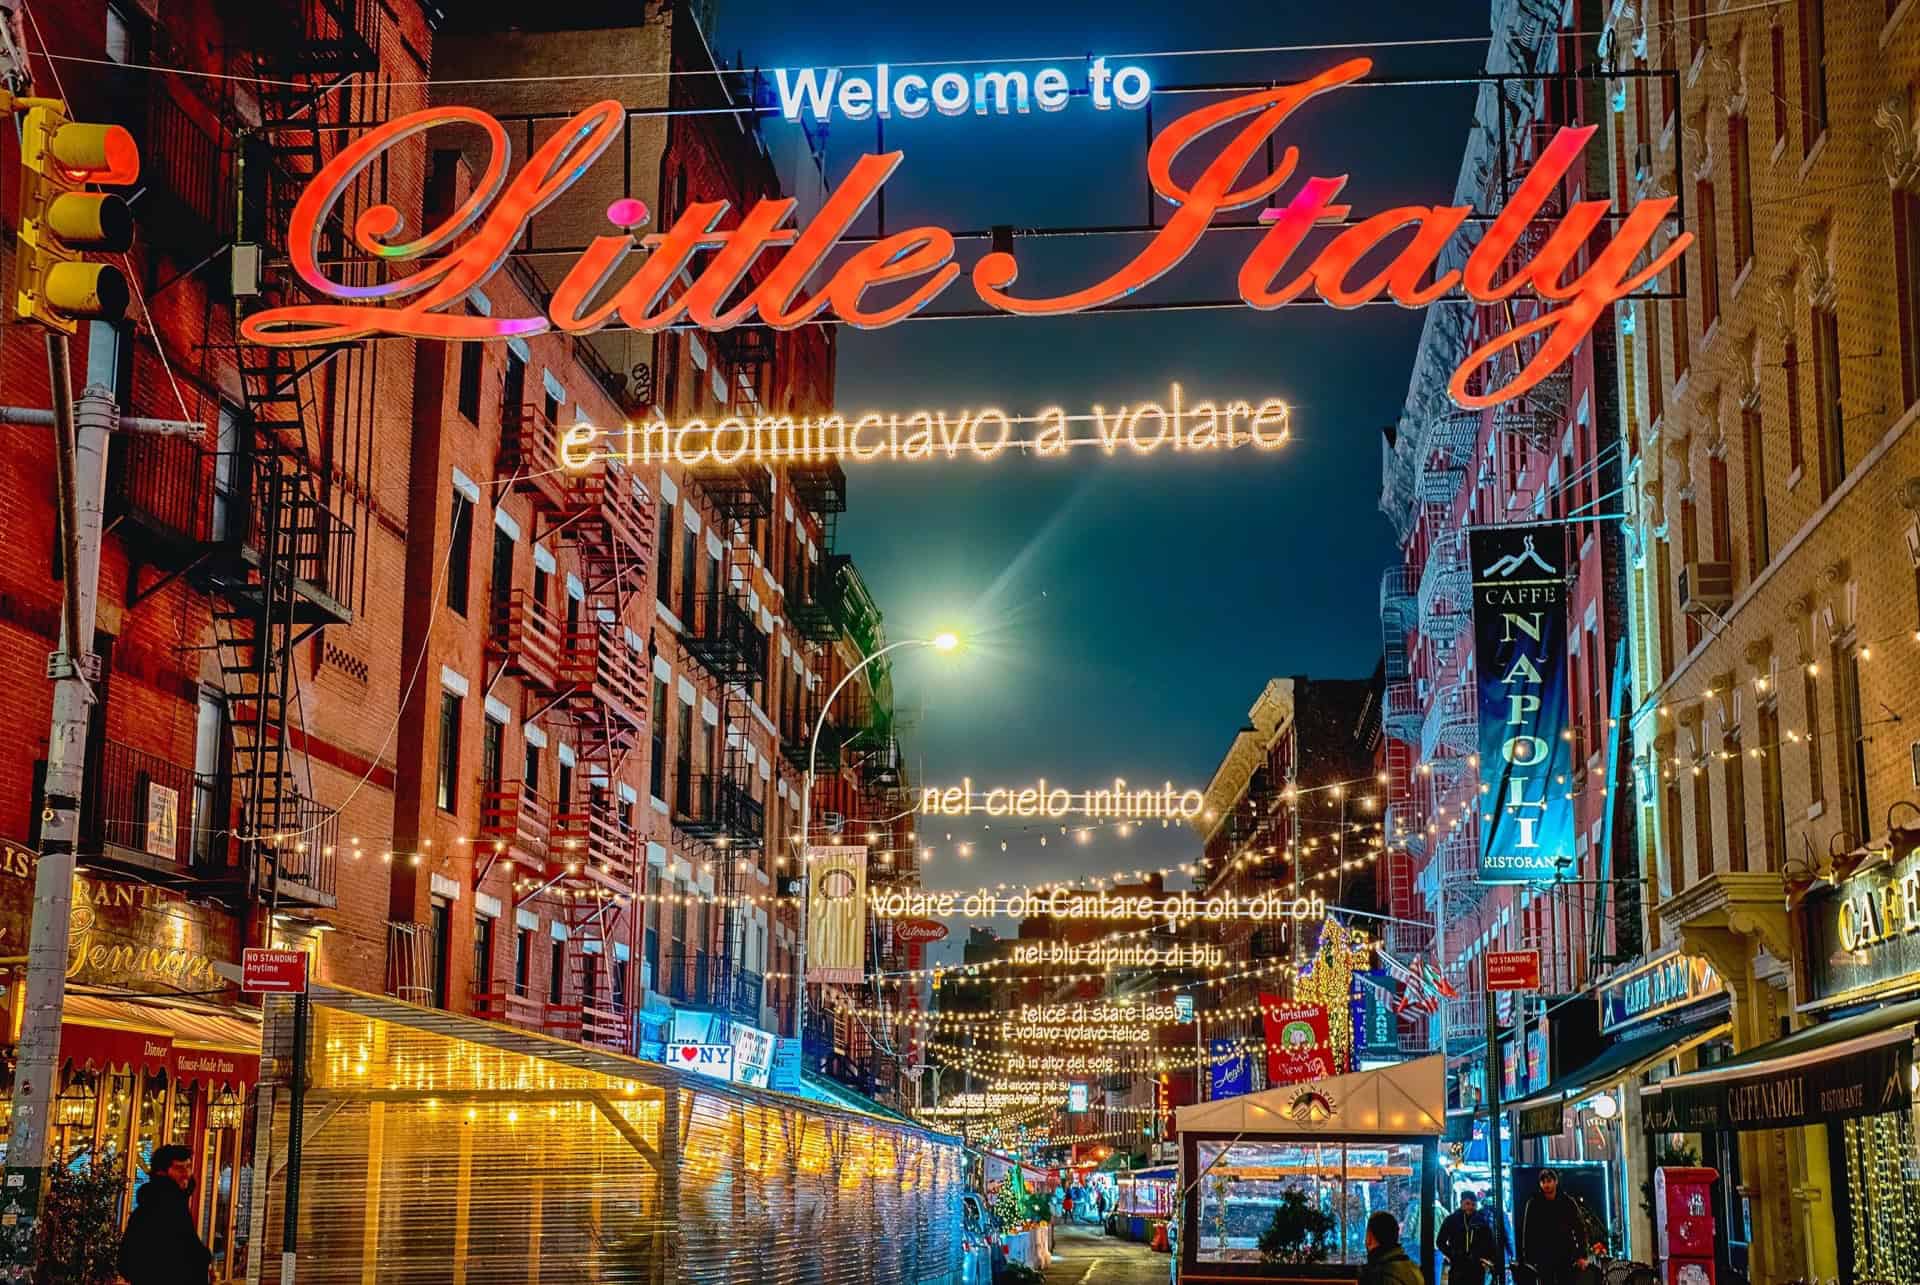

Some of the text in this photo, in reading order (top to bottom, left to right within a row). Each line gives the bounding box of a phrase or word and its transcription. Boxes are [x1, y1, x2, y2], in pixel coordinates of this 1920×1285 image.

[774, 56, 1152, 124] Welcome to
[241, 57, 1694, 409] Little Italy
[560, 383, 1293, 470] e incominciavo a volare
[1485, 586, 1556, 605] CAFFE
[1500, 612, 1549, 848] NAPOLI
[922, 777, 1204, 819] nel cielo infinito
[871, 886, 1325, 919] Volare oh oh Cantare oh oh oh oh
[896, 922, 948, 940] Ristorante
[247, 955, 298, 963] NO STANDING
[1014, 941, 1221, 971] nel blu dipinto di blu
[1489, 956, 1532, 965] NO STANDING
[247, 964, 279, 973] Anytime
[1489, 966, 1516, 974] Anytime
[1022, 1003, 1066, 1023] felice
[1072, 1004, 1088, 1022] di
[1093, 1002, 1136, 1022] stare
[1271, 1007, 1320, 1023] Christmas
[1016, 1022, 1059, 1040] volavo
[1065, 1022, 1107, 1041] volavo
[1112, 1022, 1150, 1042] felice
[144, 1041, 168, 1057] Dinner
[669, 1045, 731, 1064] I NY
[1820, 1084, 1864, 1112] RISTORANTE
